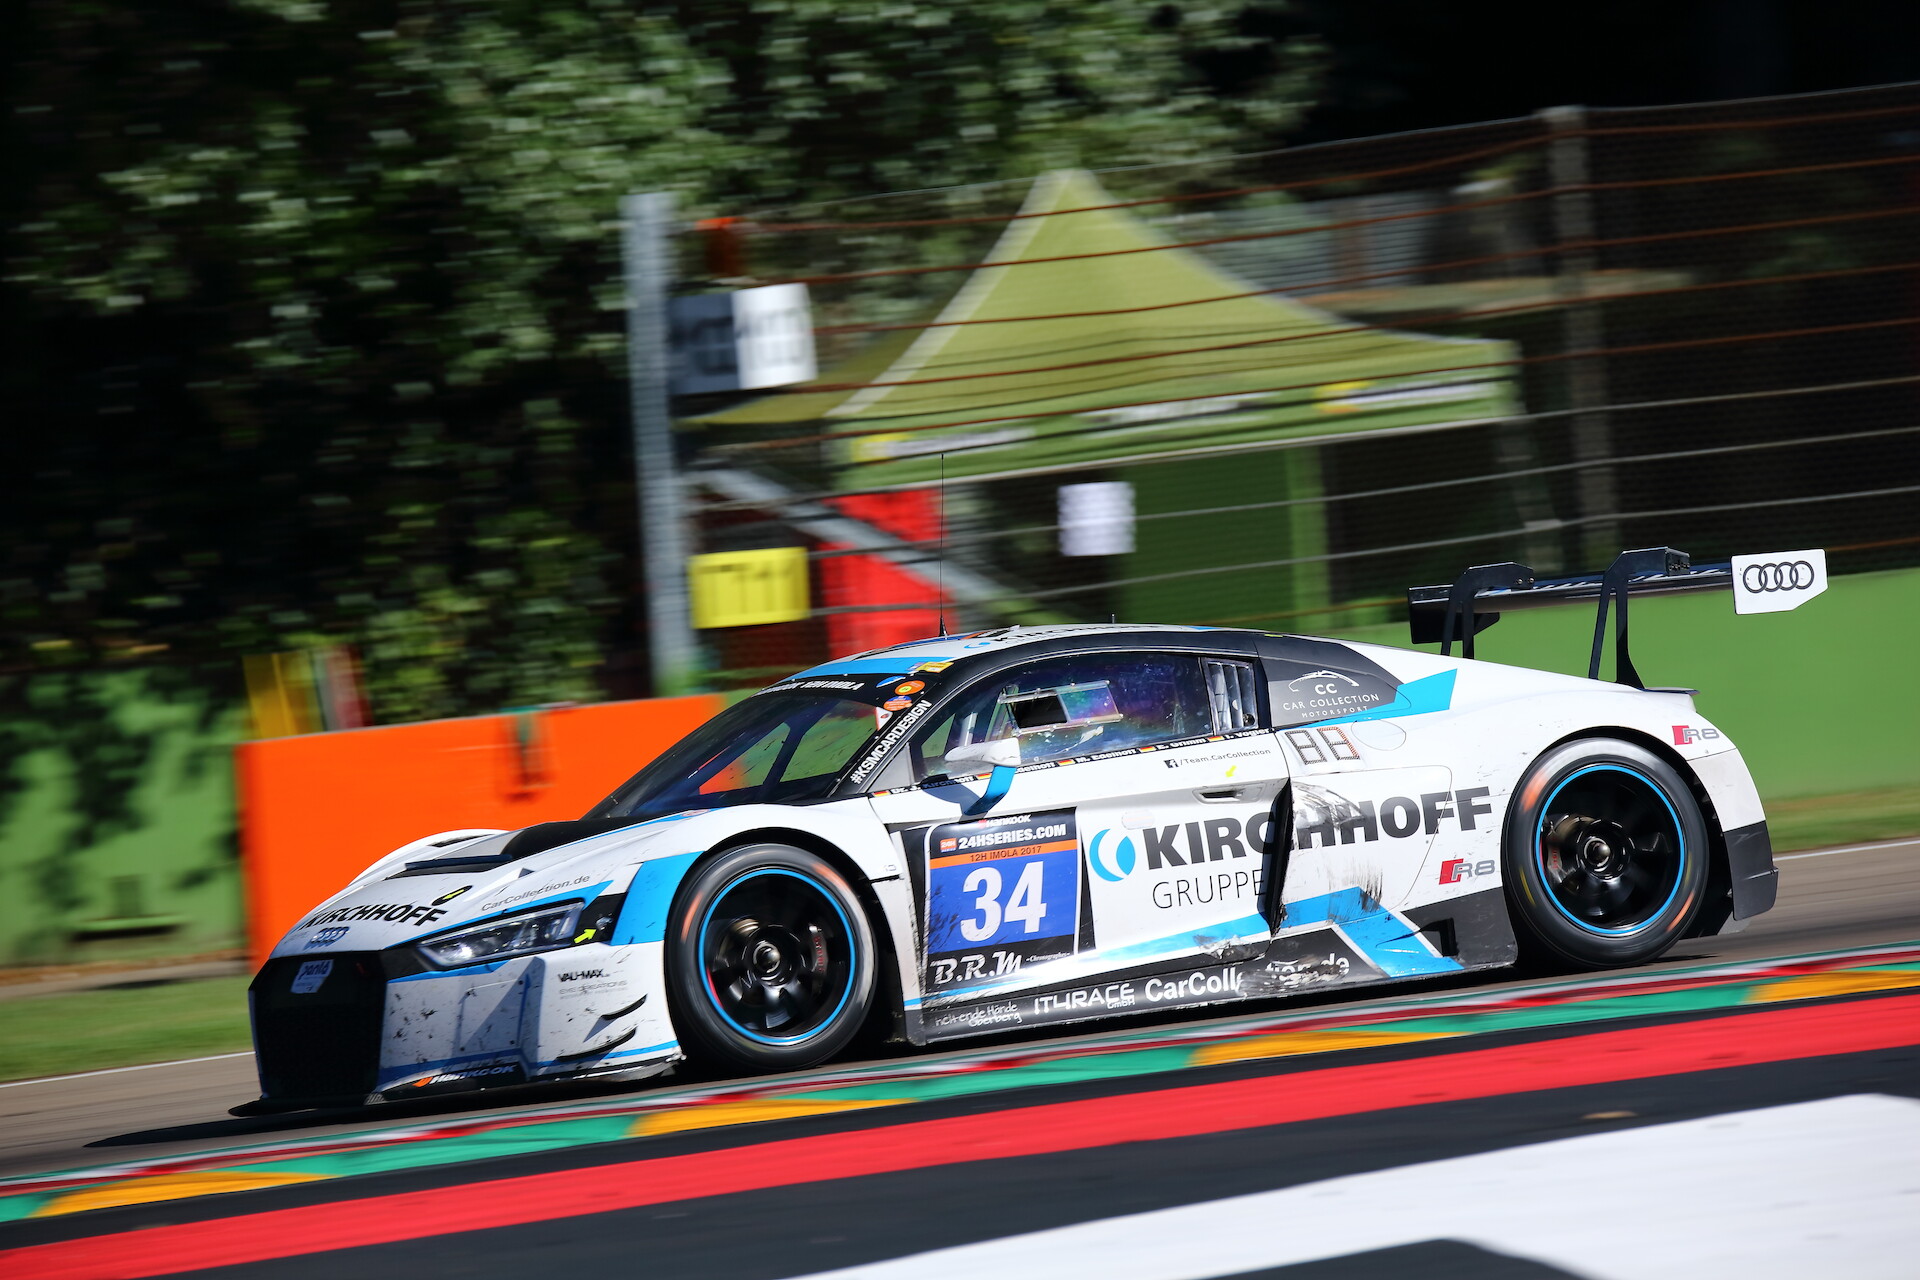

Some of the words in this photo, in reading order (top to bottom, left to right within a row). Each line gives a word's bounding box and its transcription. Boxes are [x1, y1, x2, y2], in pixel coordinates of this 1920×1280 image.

[1282, 701, 1306, 711] CAR
[1309, 693, 1380, 708] COLLECTION
[1314, 683, 1338, 695] CC
[1301, 705, 1369, 719] MOTORSPORT
[849, 699, 933, 785] #KSMCARDESIGN
[1683, 727, 1720, 742] R8
[958, 823, 1067, 850] 24HSERIES.COM
[1142, 786, 1492, 871] KIRCHHOFF
[969, 852, 988, 863] 12H
[989, 847, 1019, 861] IMOLA
[1020, 845, 1043, 856] 2017
[1452, 859, 1496, 880] R8
[481, 874, 591, 912] CarCollection.de
[960, 860, 1048, 942] 34
[1152, 868, 1265, 909] GRUPPE
[298, 903, 449, 931] KIRCHHOFF
[929, 950, 1023, 985] B.R.M
